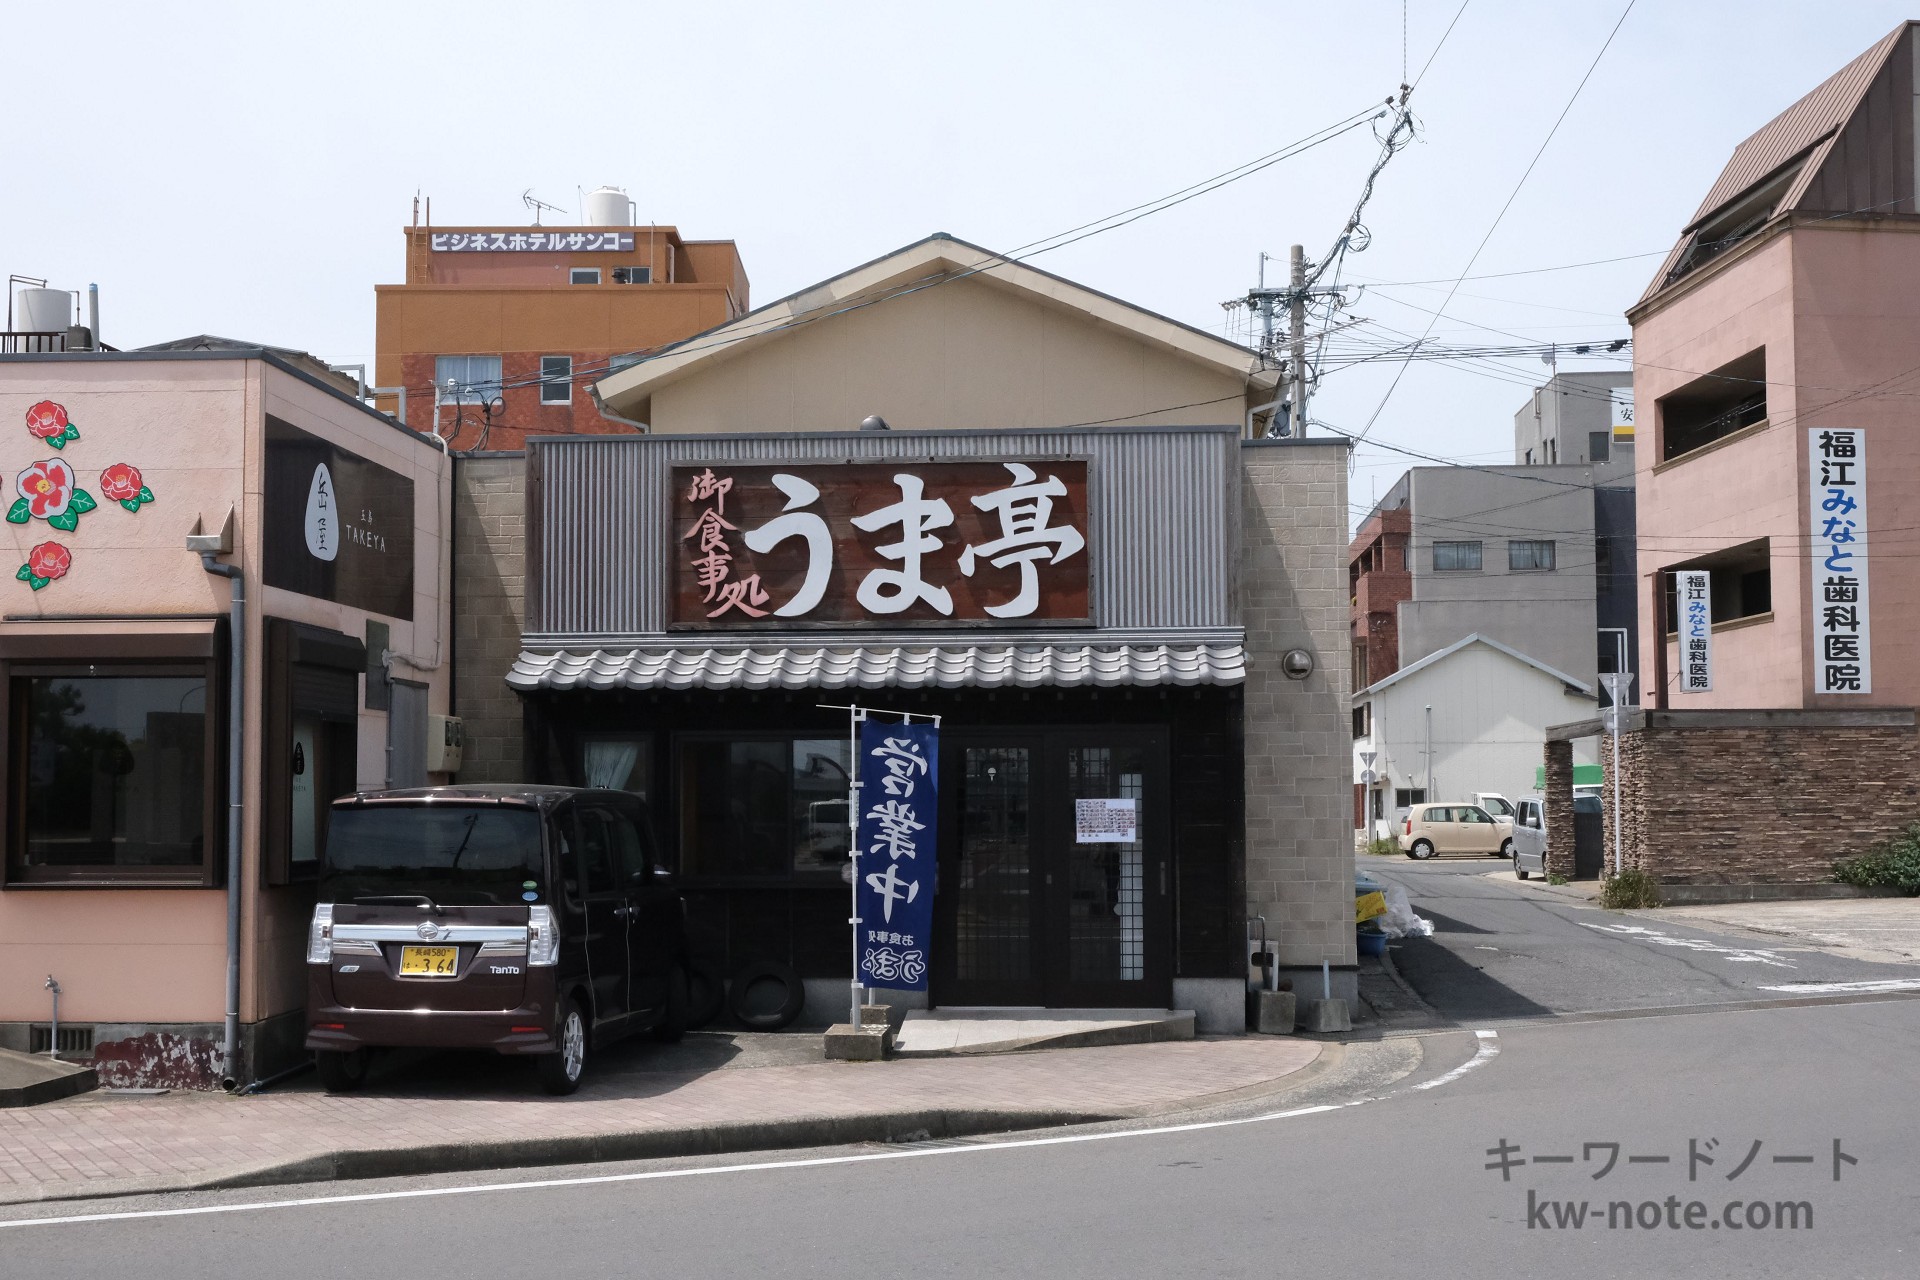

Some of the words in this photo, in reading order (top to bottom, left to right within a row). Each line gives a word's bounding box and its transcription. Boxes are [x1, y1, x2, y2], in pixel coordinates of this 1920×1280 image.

[432, 233, 632, 250] ビジネスホテルサンコー
[346, 524, 386, 553] TAKEYA
[684, 468, 771, 618] 御食事処
[744, 463, 1085, 618] うま亭
[1819, 431, 1860, 691] 福江みなと歯科医院
[1687, 575, 1708, 688] 福江みなと歯科医院
